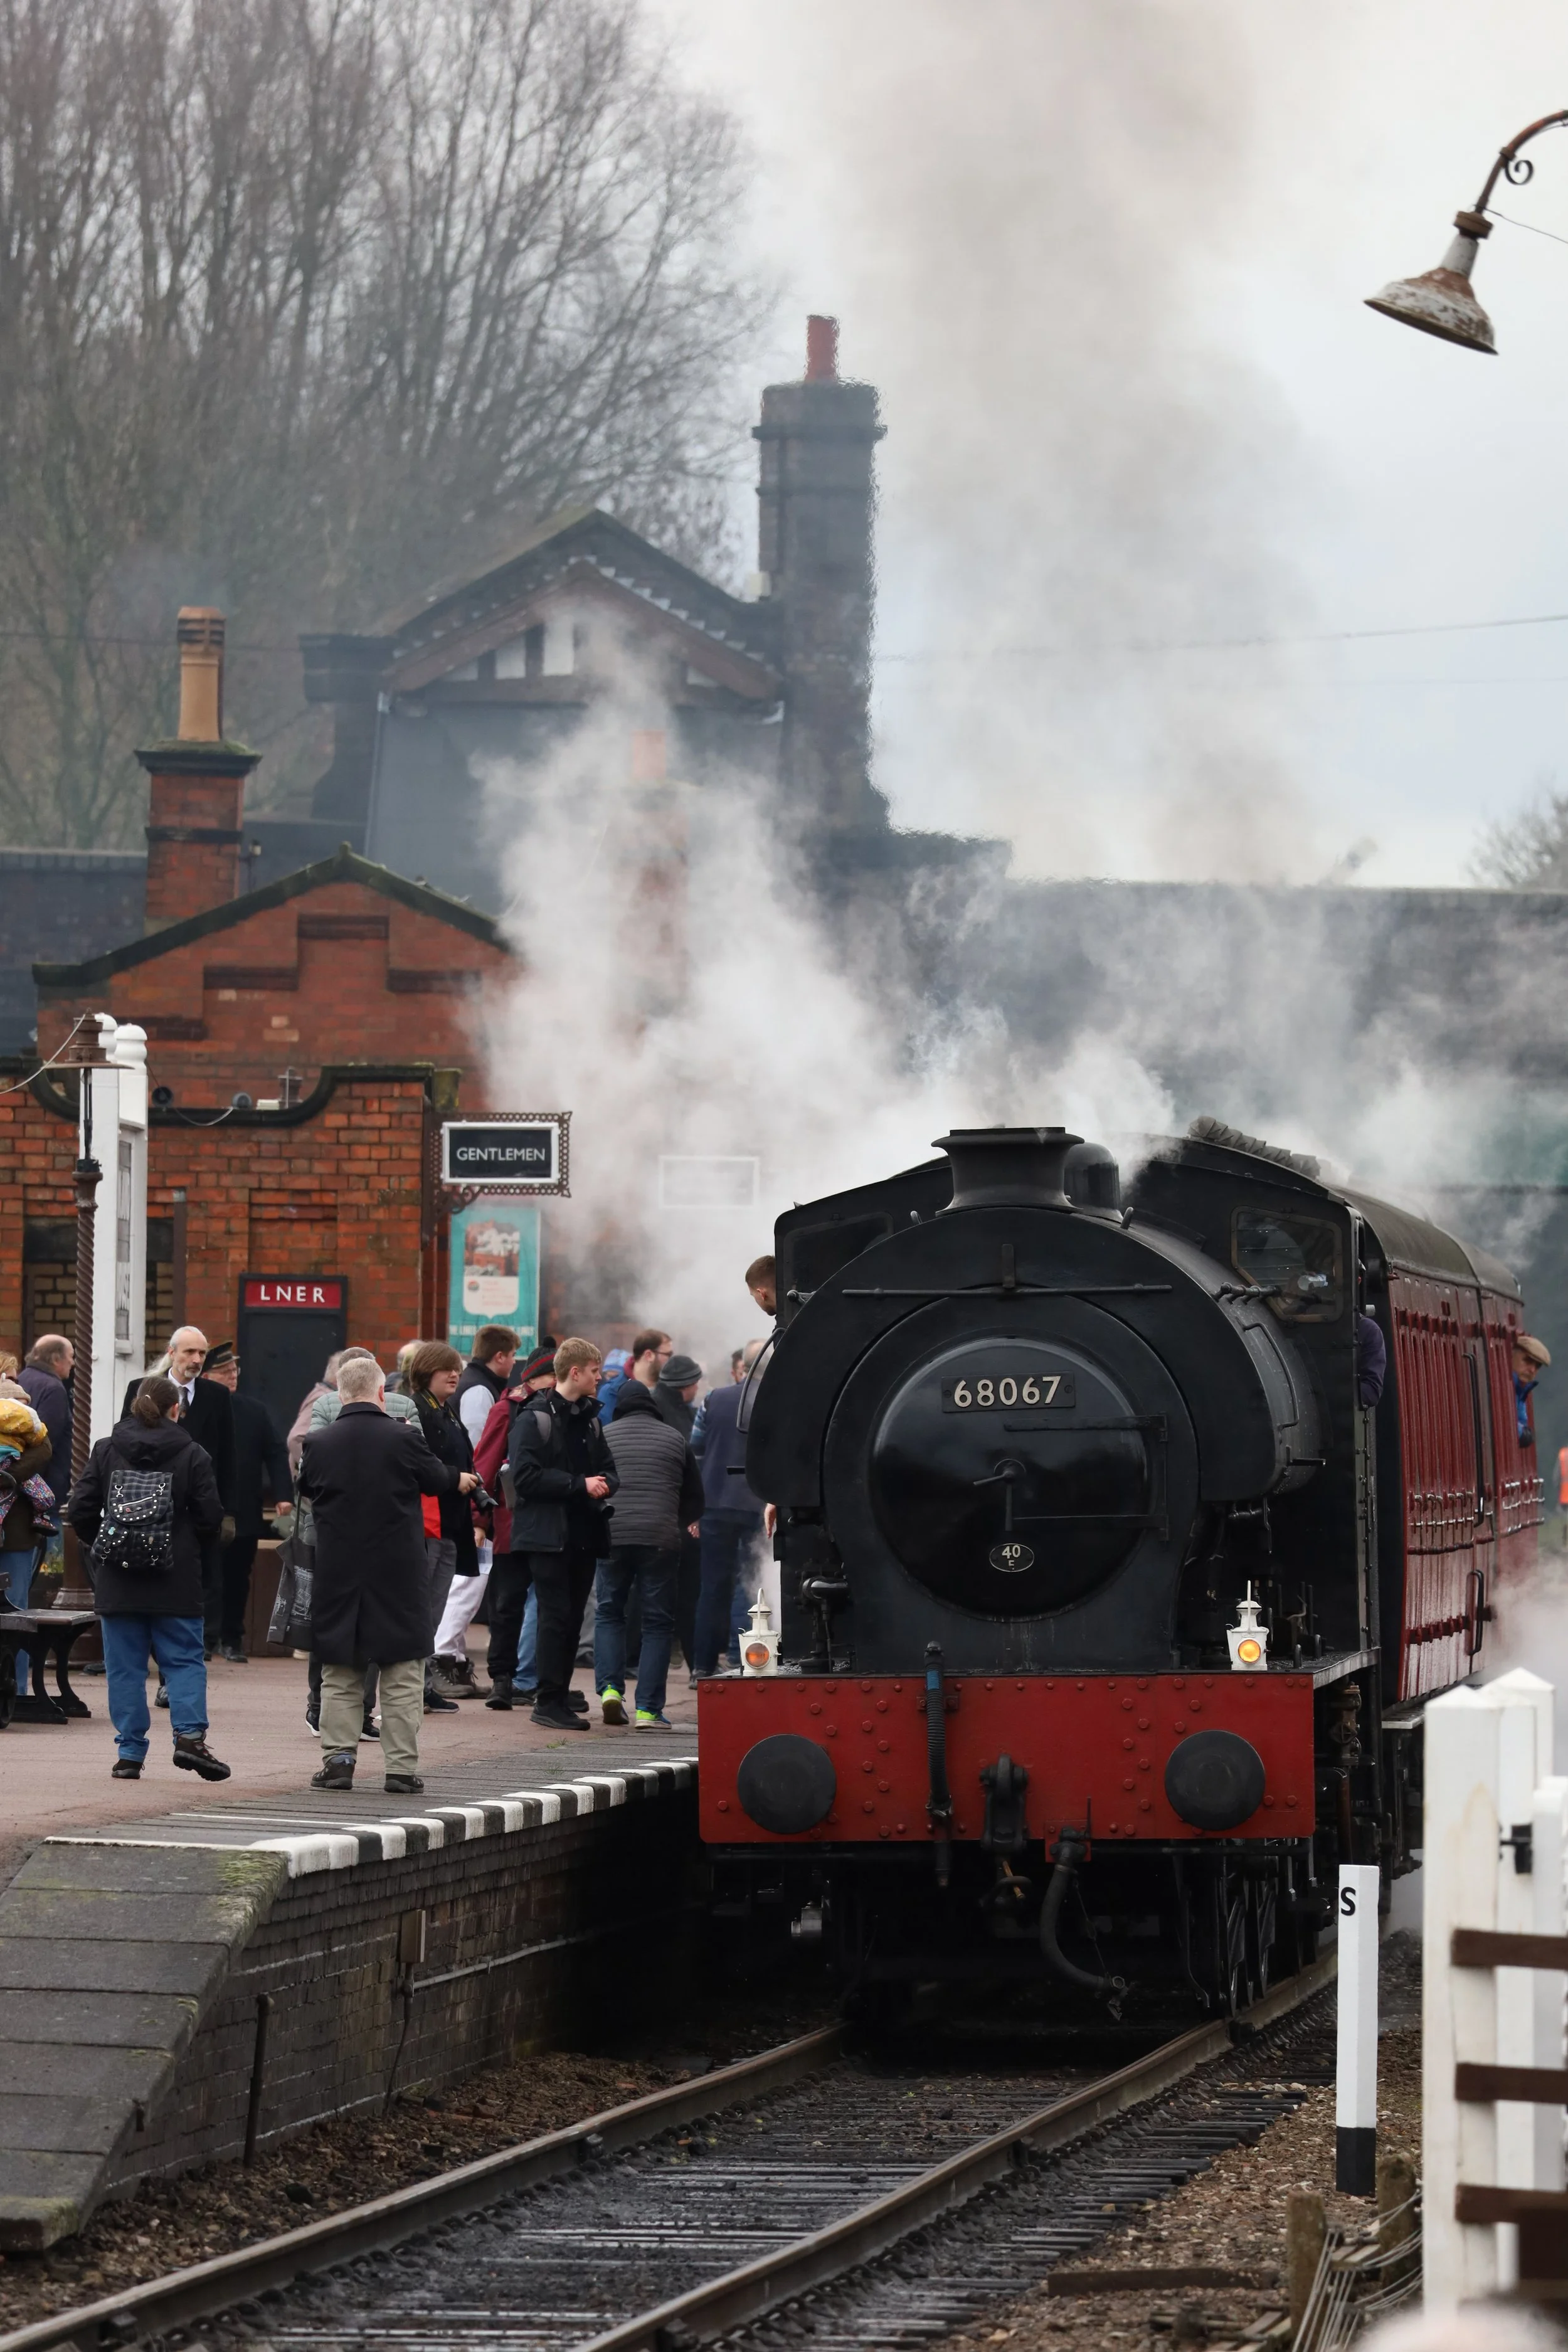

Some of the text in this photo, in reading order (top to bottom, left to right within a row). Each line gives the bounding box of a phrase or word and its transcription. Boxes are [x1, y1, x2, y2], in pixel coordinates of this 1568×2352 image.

[456, 1147, 546, 1161] GENTLEMEN
[260, 1284, 326, 1303] LNER
[954, 1375, 1061, 1407] 68067
[1002, 1545, 1021, 1559] 40
[1340, 1886, 1356, 1916] S
